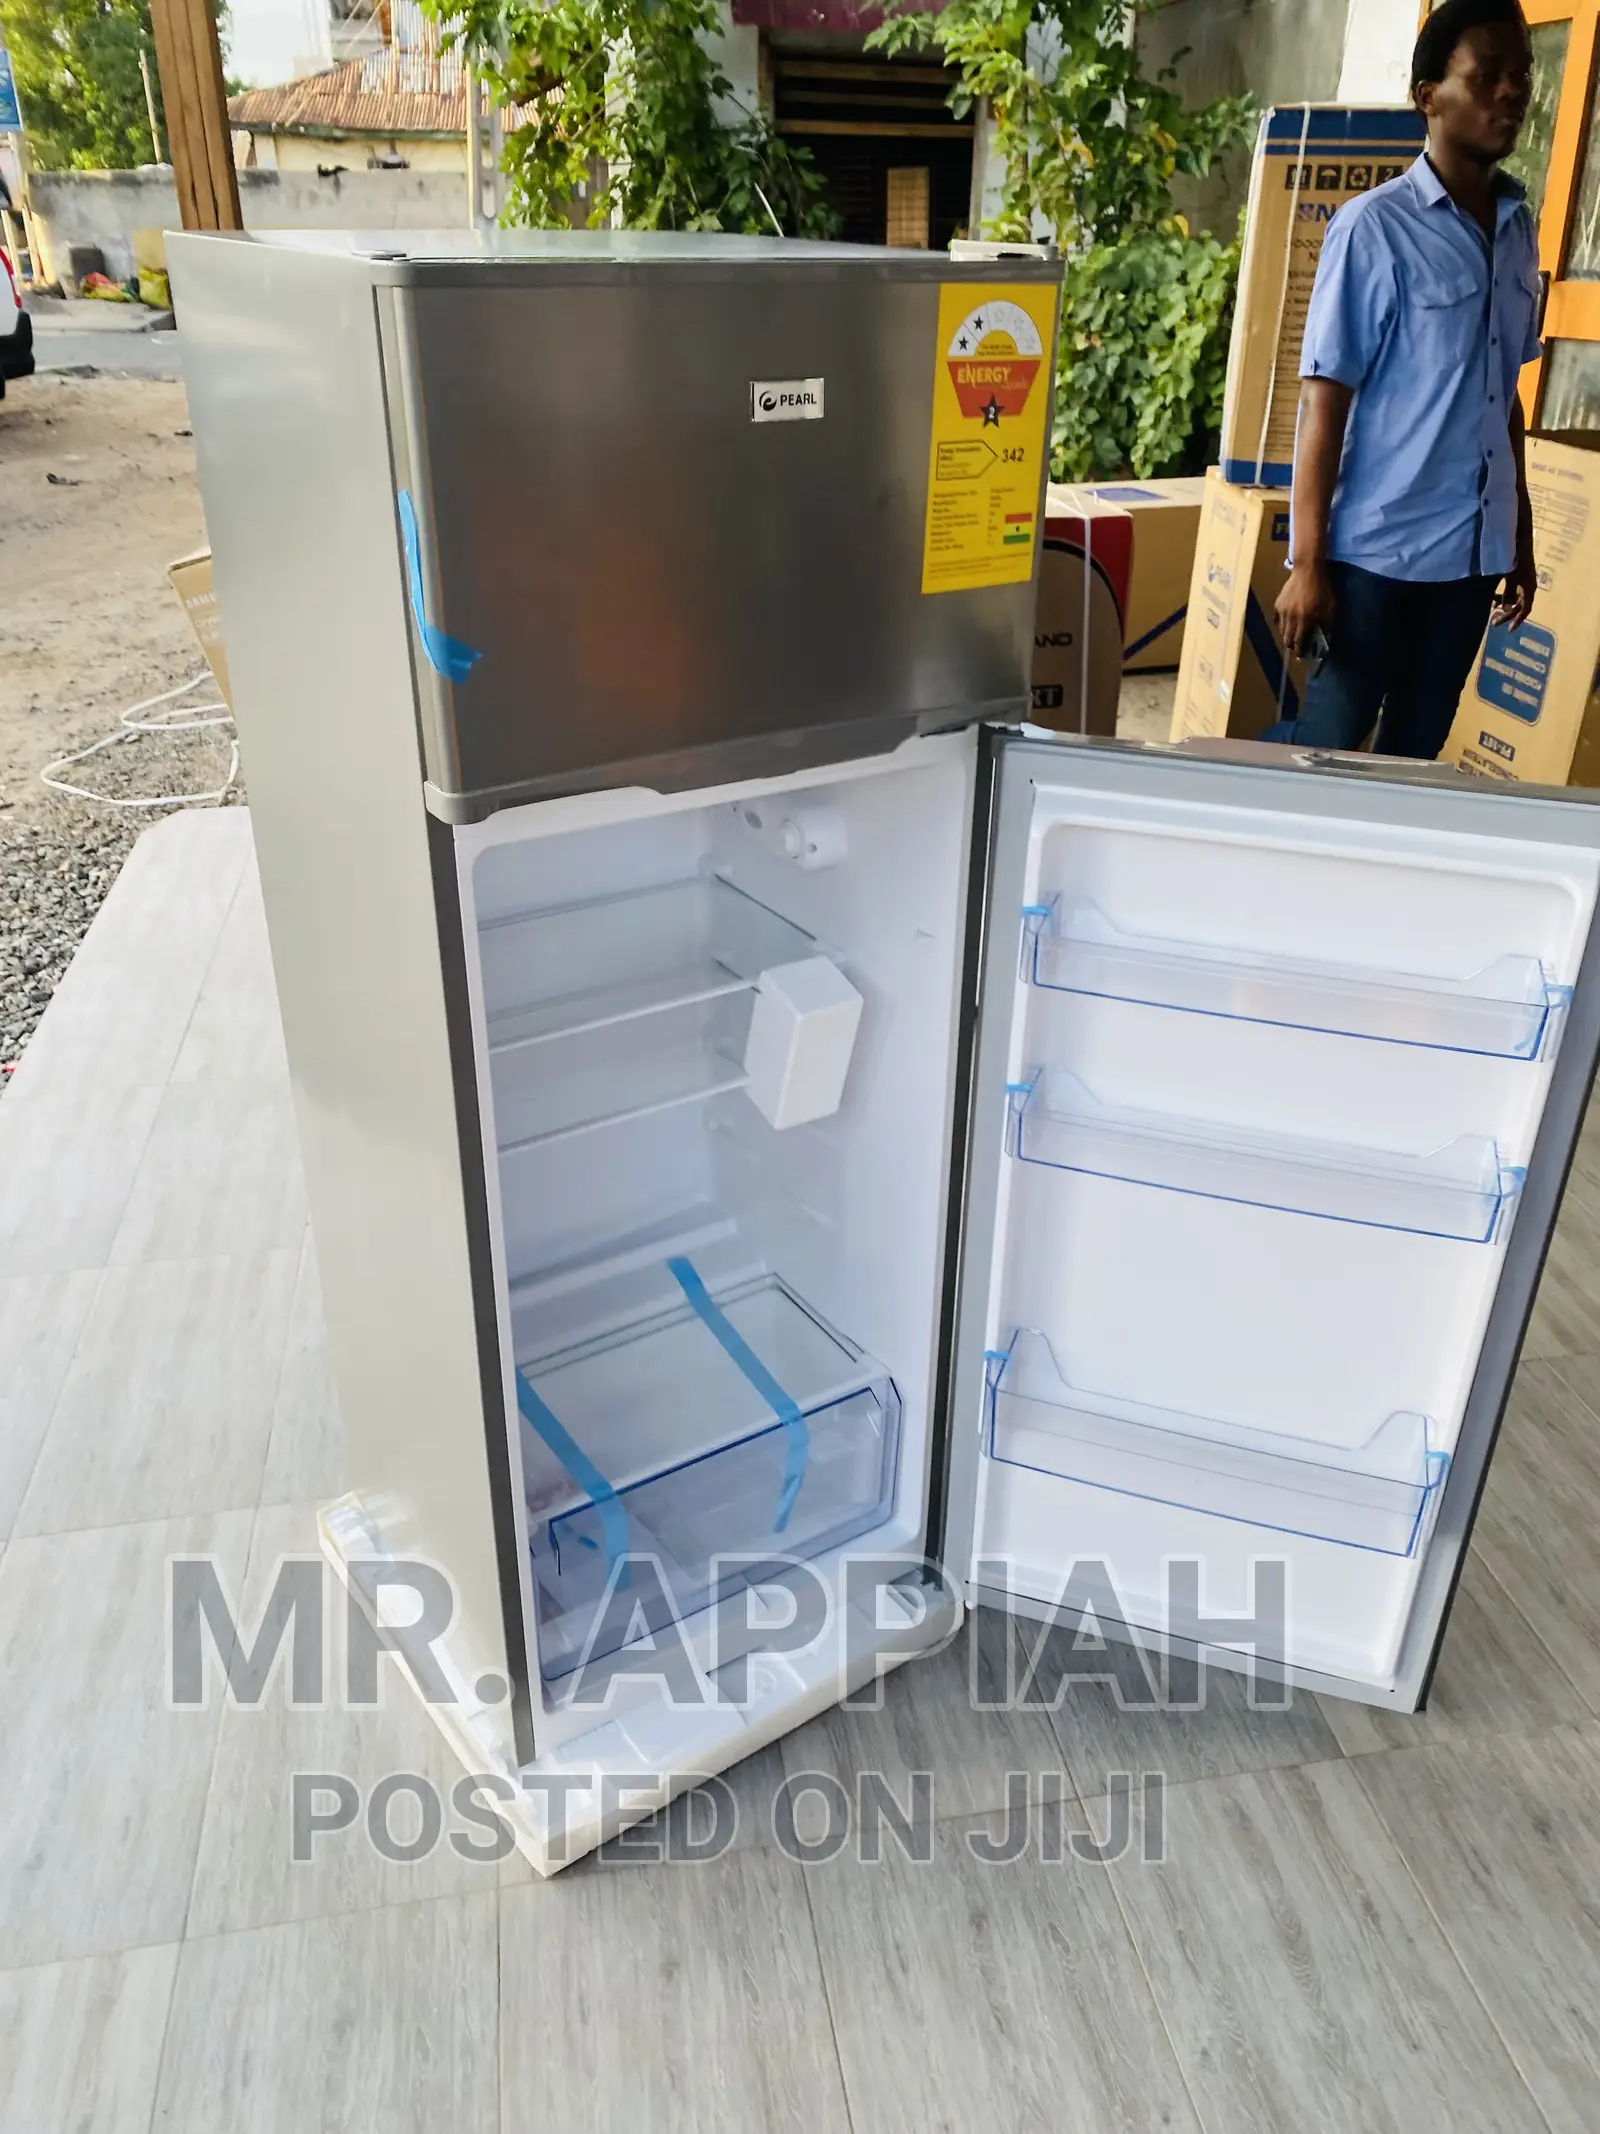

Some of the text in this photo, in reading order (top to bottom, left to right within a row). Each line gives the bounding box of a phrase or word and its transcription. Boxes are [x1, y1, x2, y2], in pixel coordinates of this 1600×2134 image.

[957, 362, 1012, 388] ENERGY
[780, 393, 817, 407] PEARL
[988, 406, 996, 419] 2
[1002, 447, 1024, 463] 342
